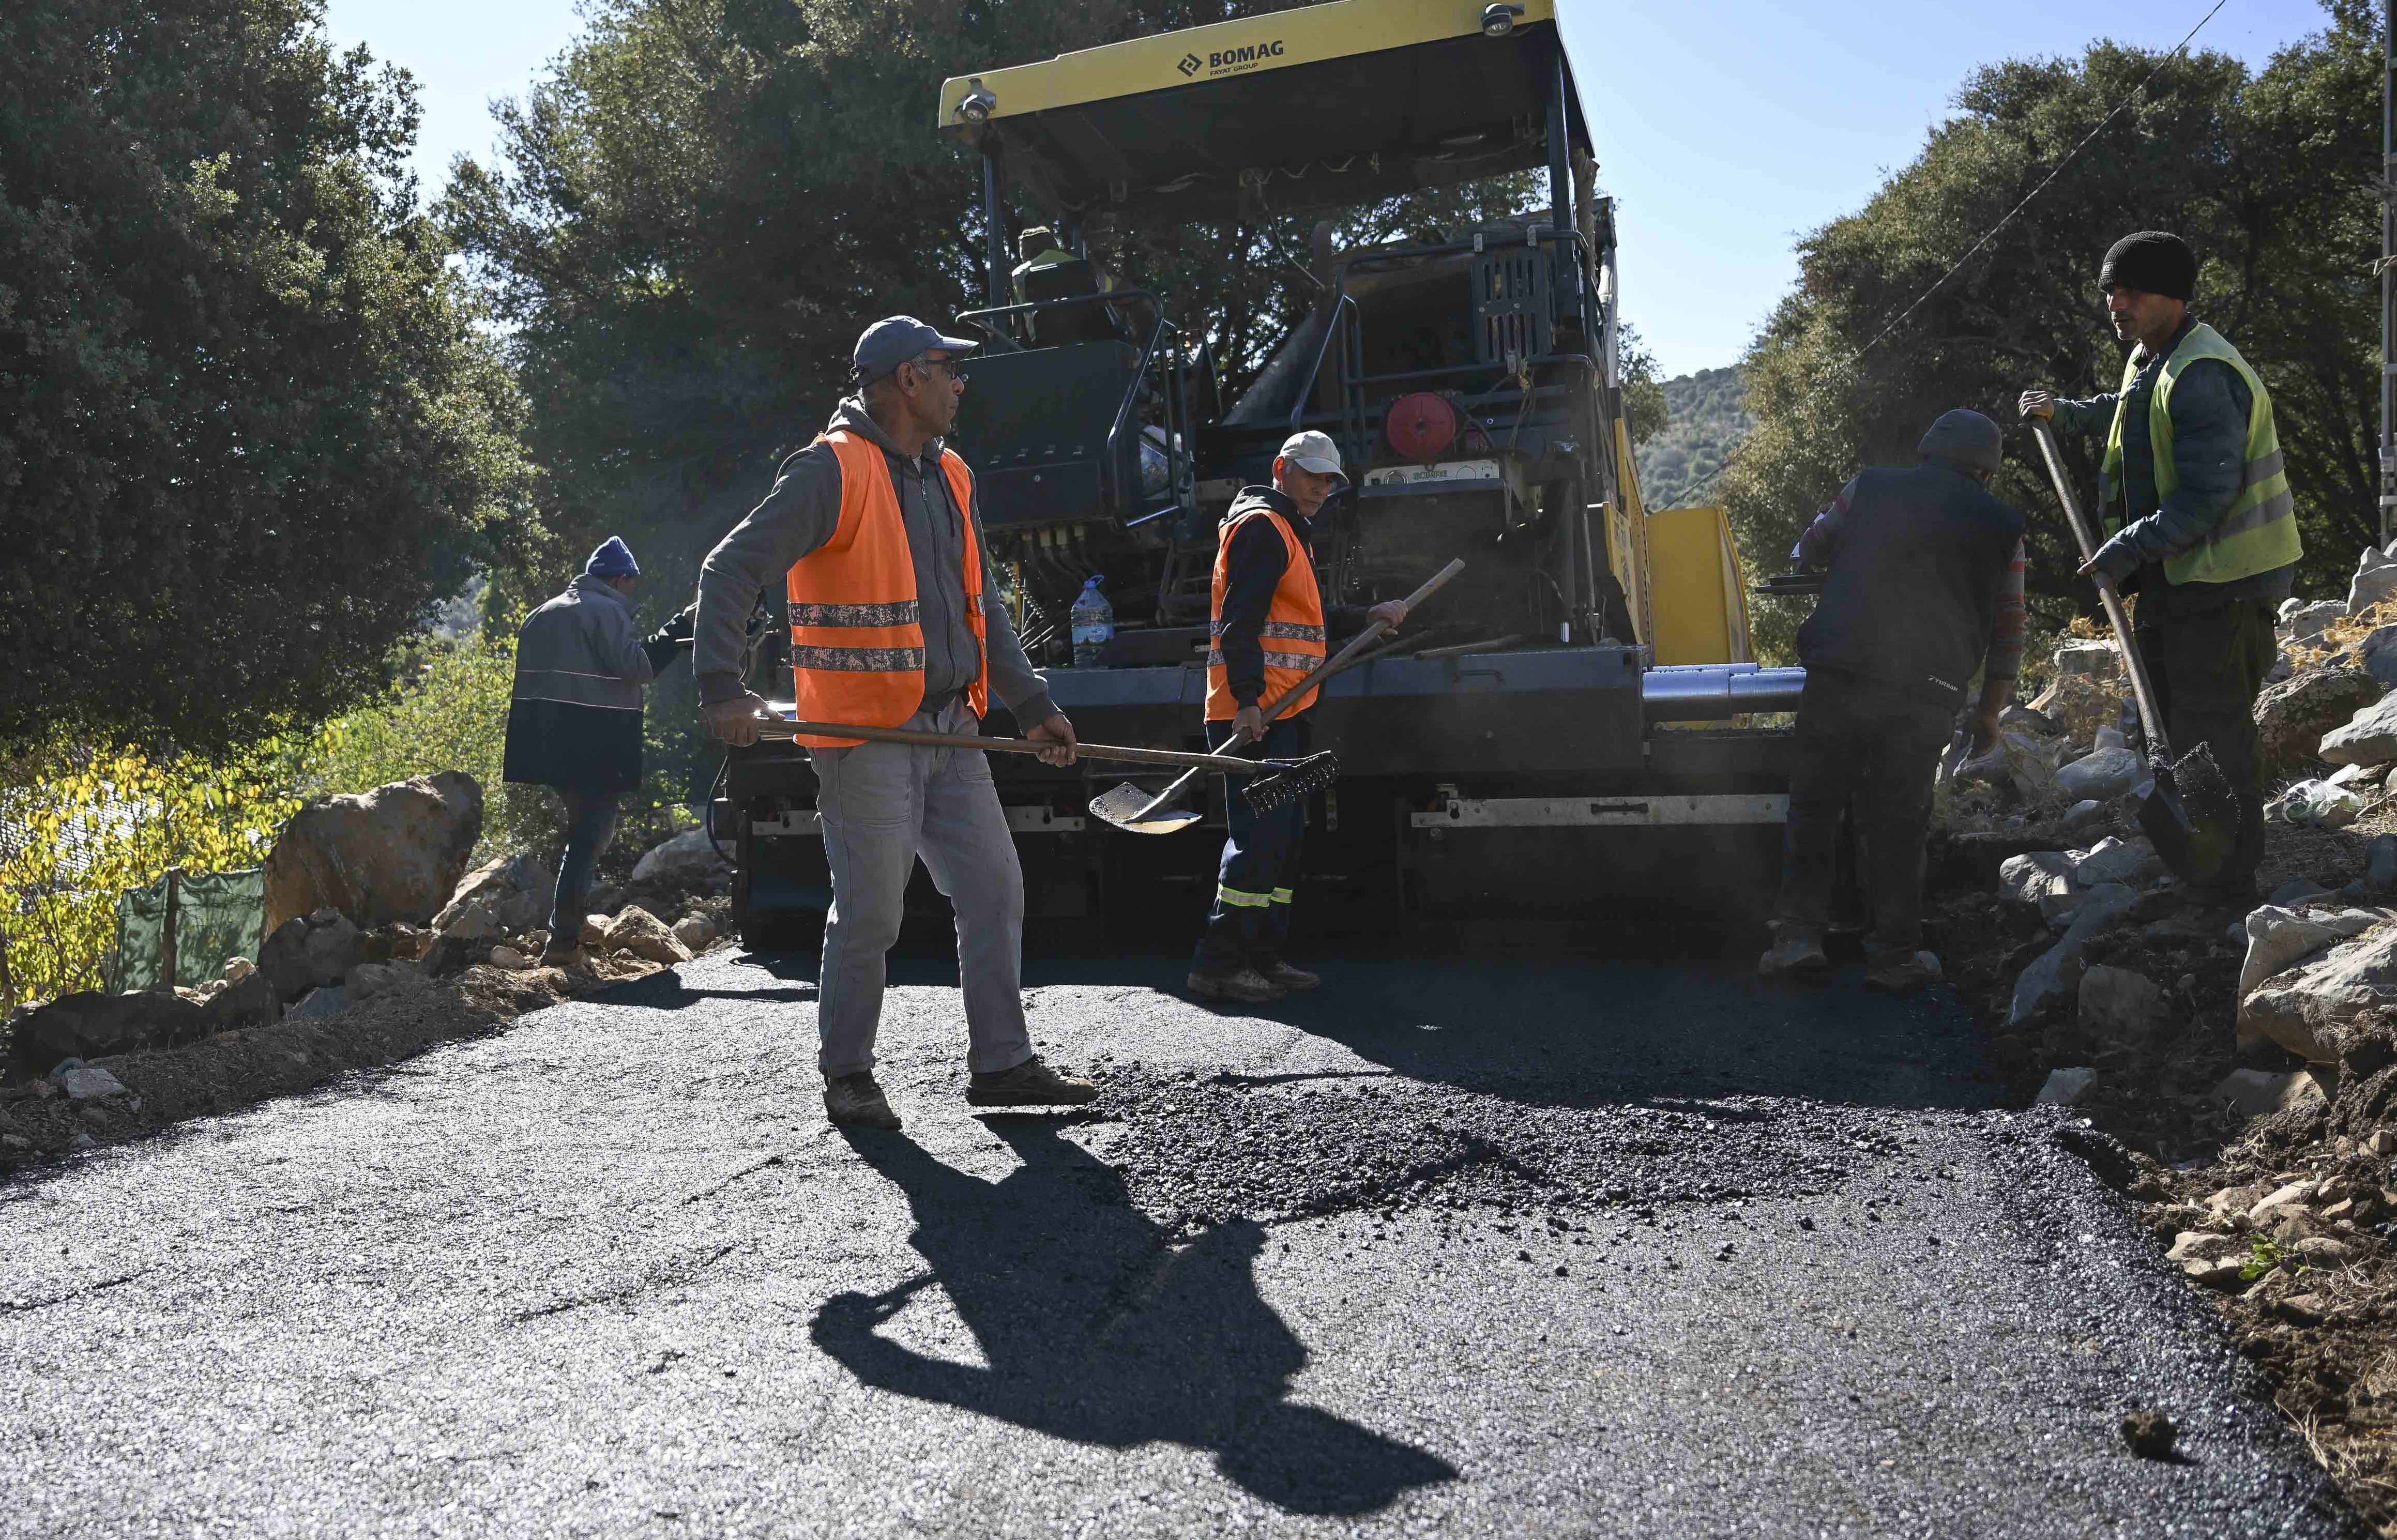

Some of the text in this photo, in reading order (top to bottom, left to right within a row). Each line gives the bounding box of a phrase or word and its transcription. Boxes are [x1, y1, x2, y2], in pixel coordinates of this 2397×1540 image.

[1209, 40, 1284, 68] BOMAG
[1210, 63, 1258, 76] FAYAT GROUP
